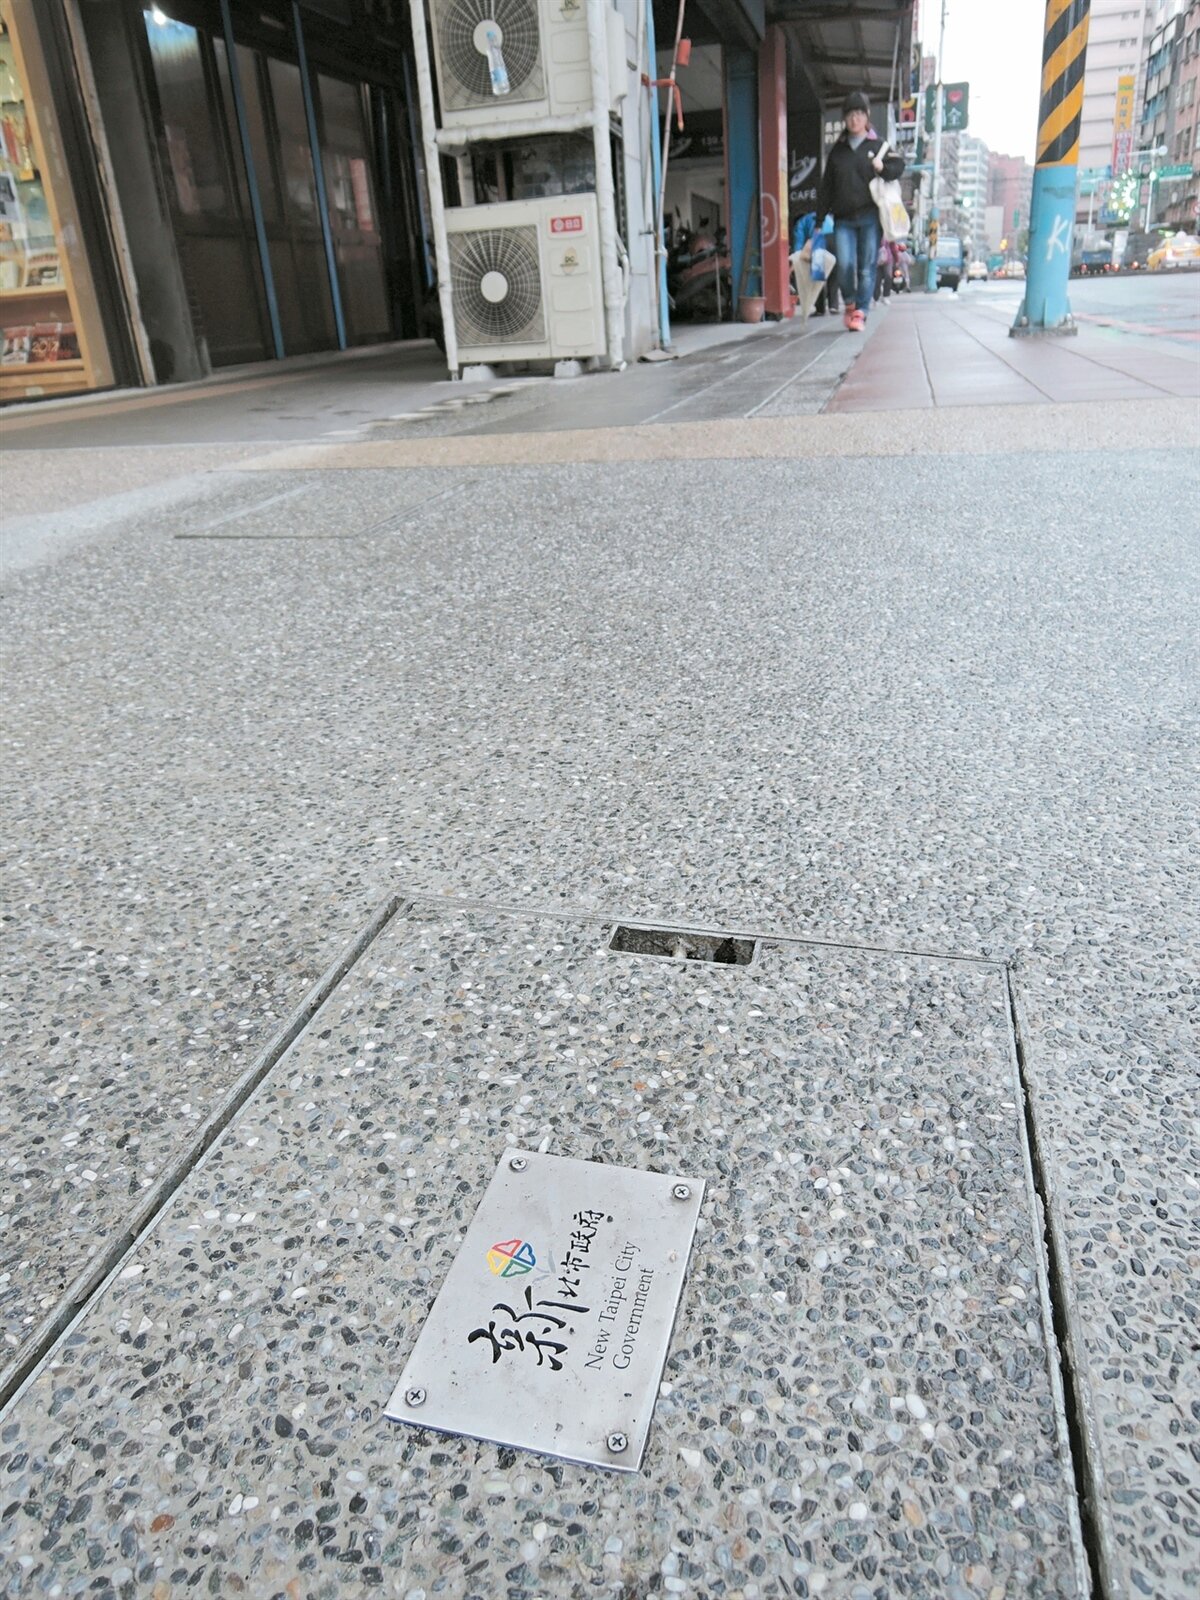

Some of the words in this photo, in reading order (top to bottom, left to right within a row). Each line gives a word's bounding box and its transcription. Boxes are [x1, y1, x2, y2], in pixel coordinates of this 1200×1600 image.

[790, 187, 817, 200] CAFÉ
[468, 1209, 605, 1371] 新北市政府
[584, 1328, 612, 1370] New
[598, 1276, 627, 1323] Taipei
[614, 1241, 641, 1273] City
[612, 1268, 655, 1370] Government
